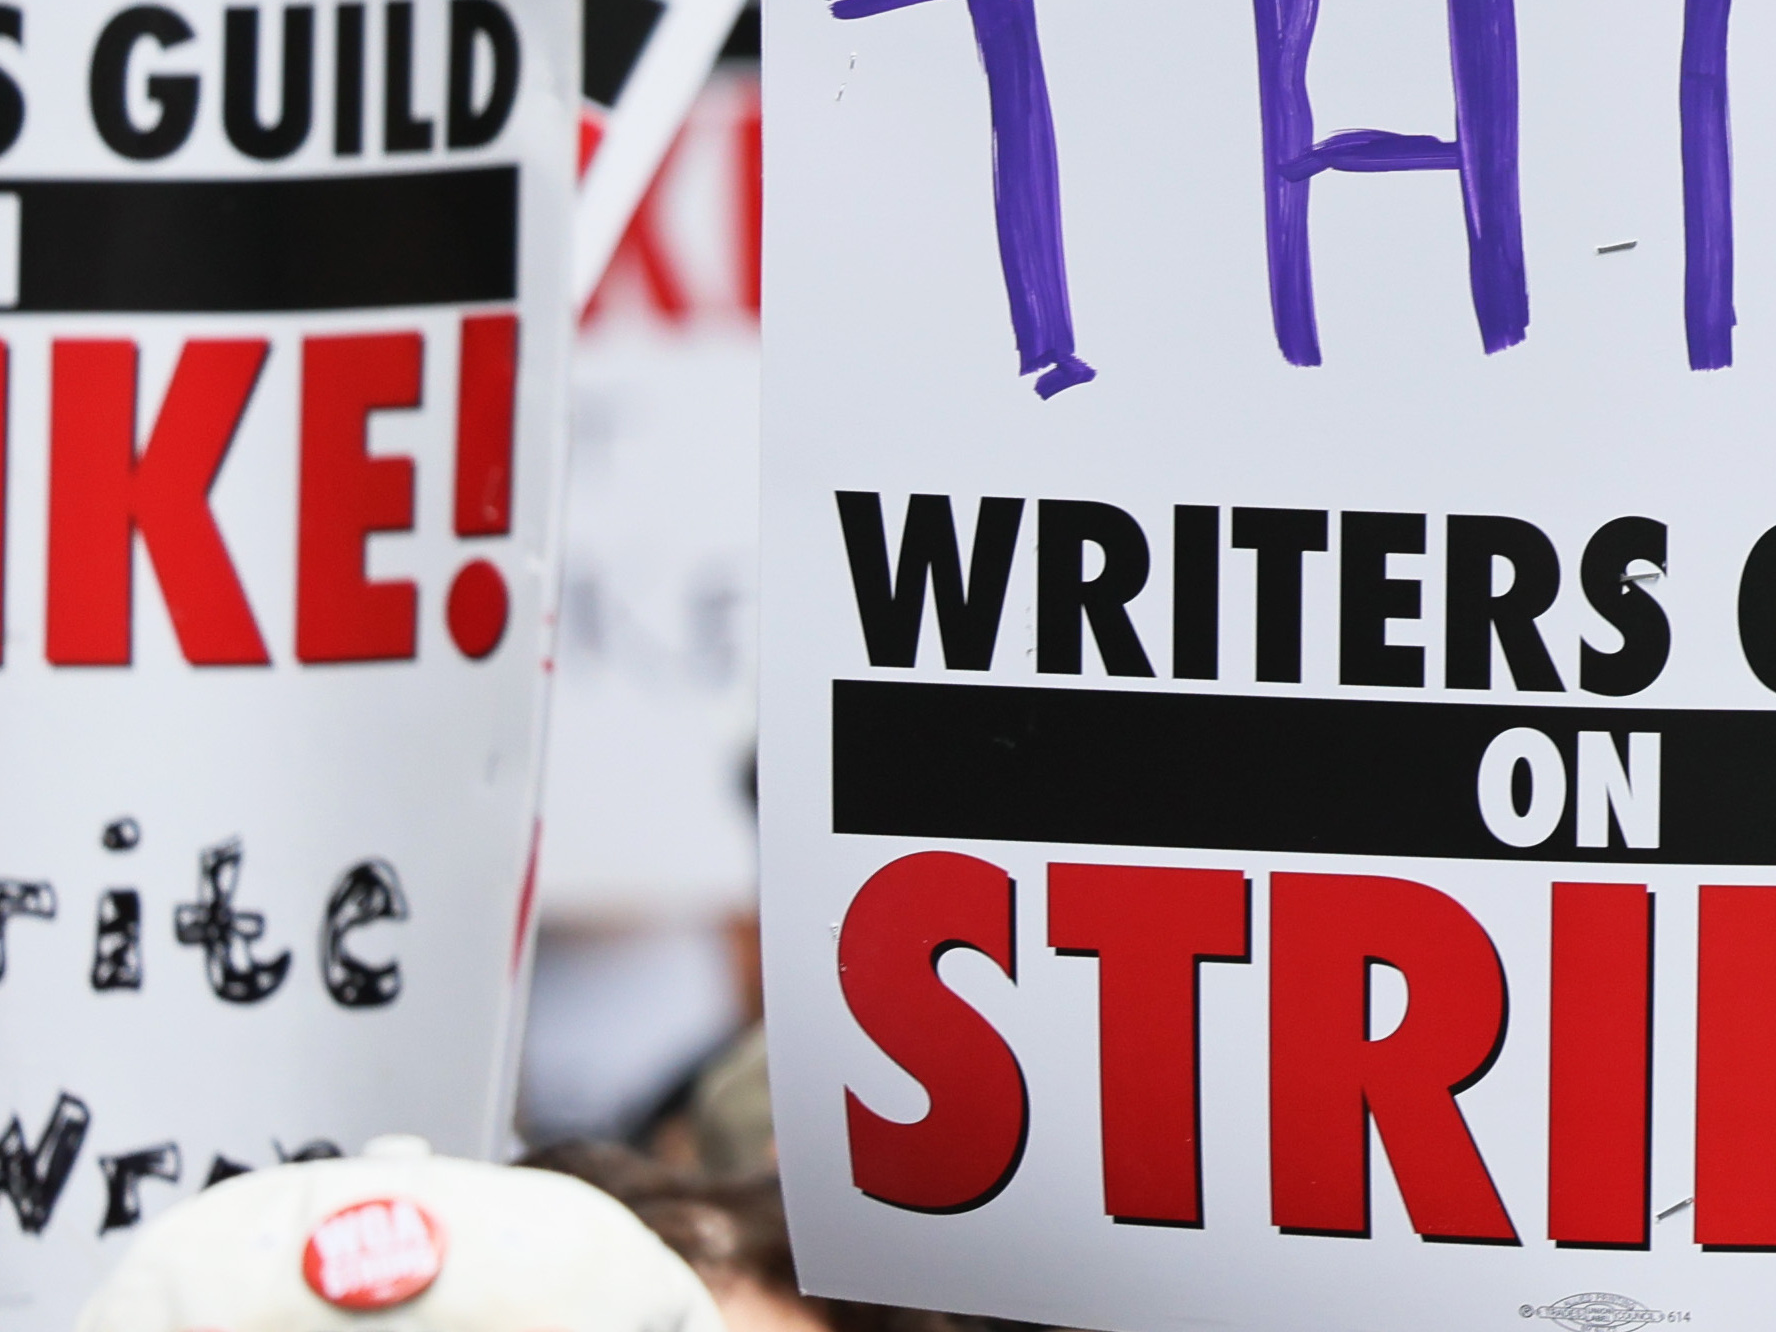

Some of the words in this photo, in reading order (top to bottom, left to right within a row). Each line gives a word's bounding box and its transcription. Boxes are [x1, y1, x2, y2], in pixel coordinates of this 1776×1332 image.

[832, 490, 1672, 698] WRITERS
[1477, 726, 1662, 849] ON
[1666, 1311, 1692, 1324] 614
